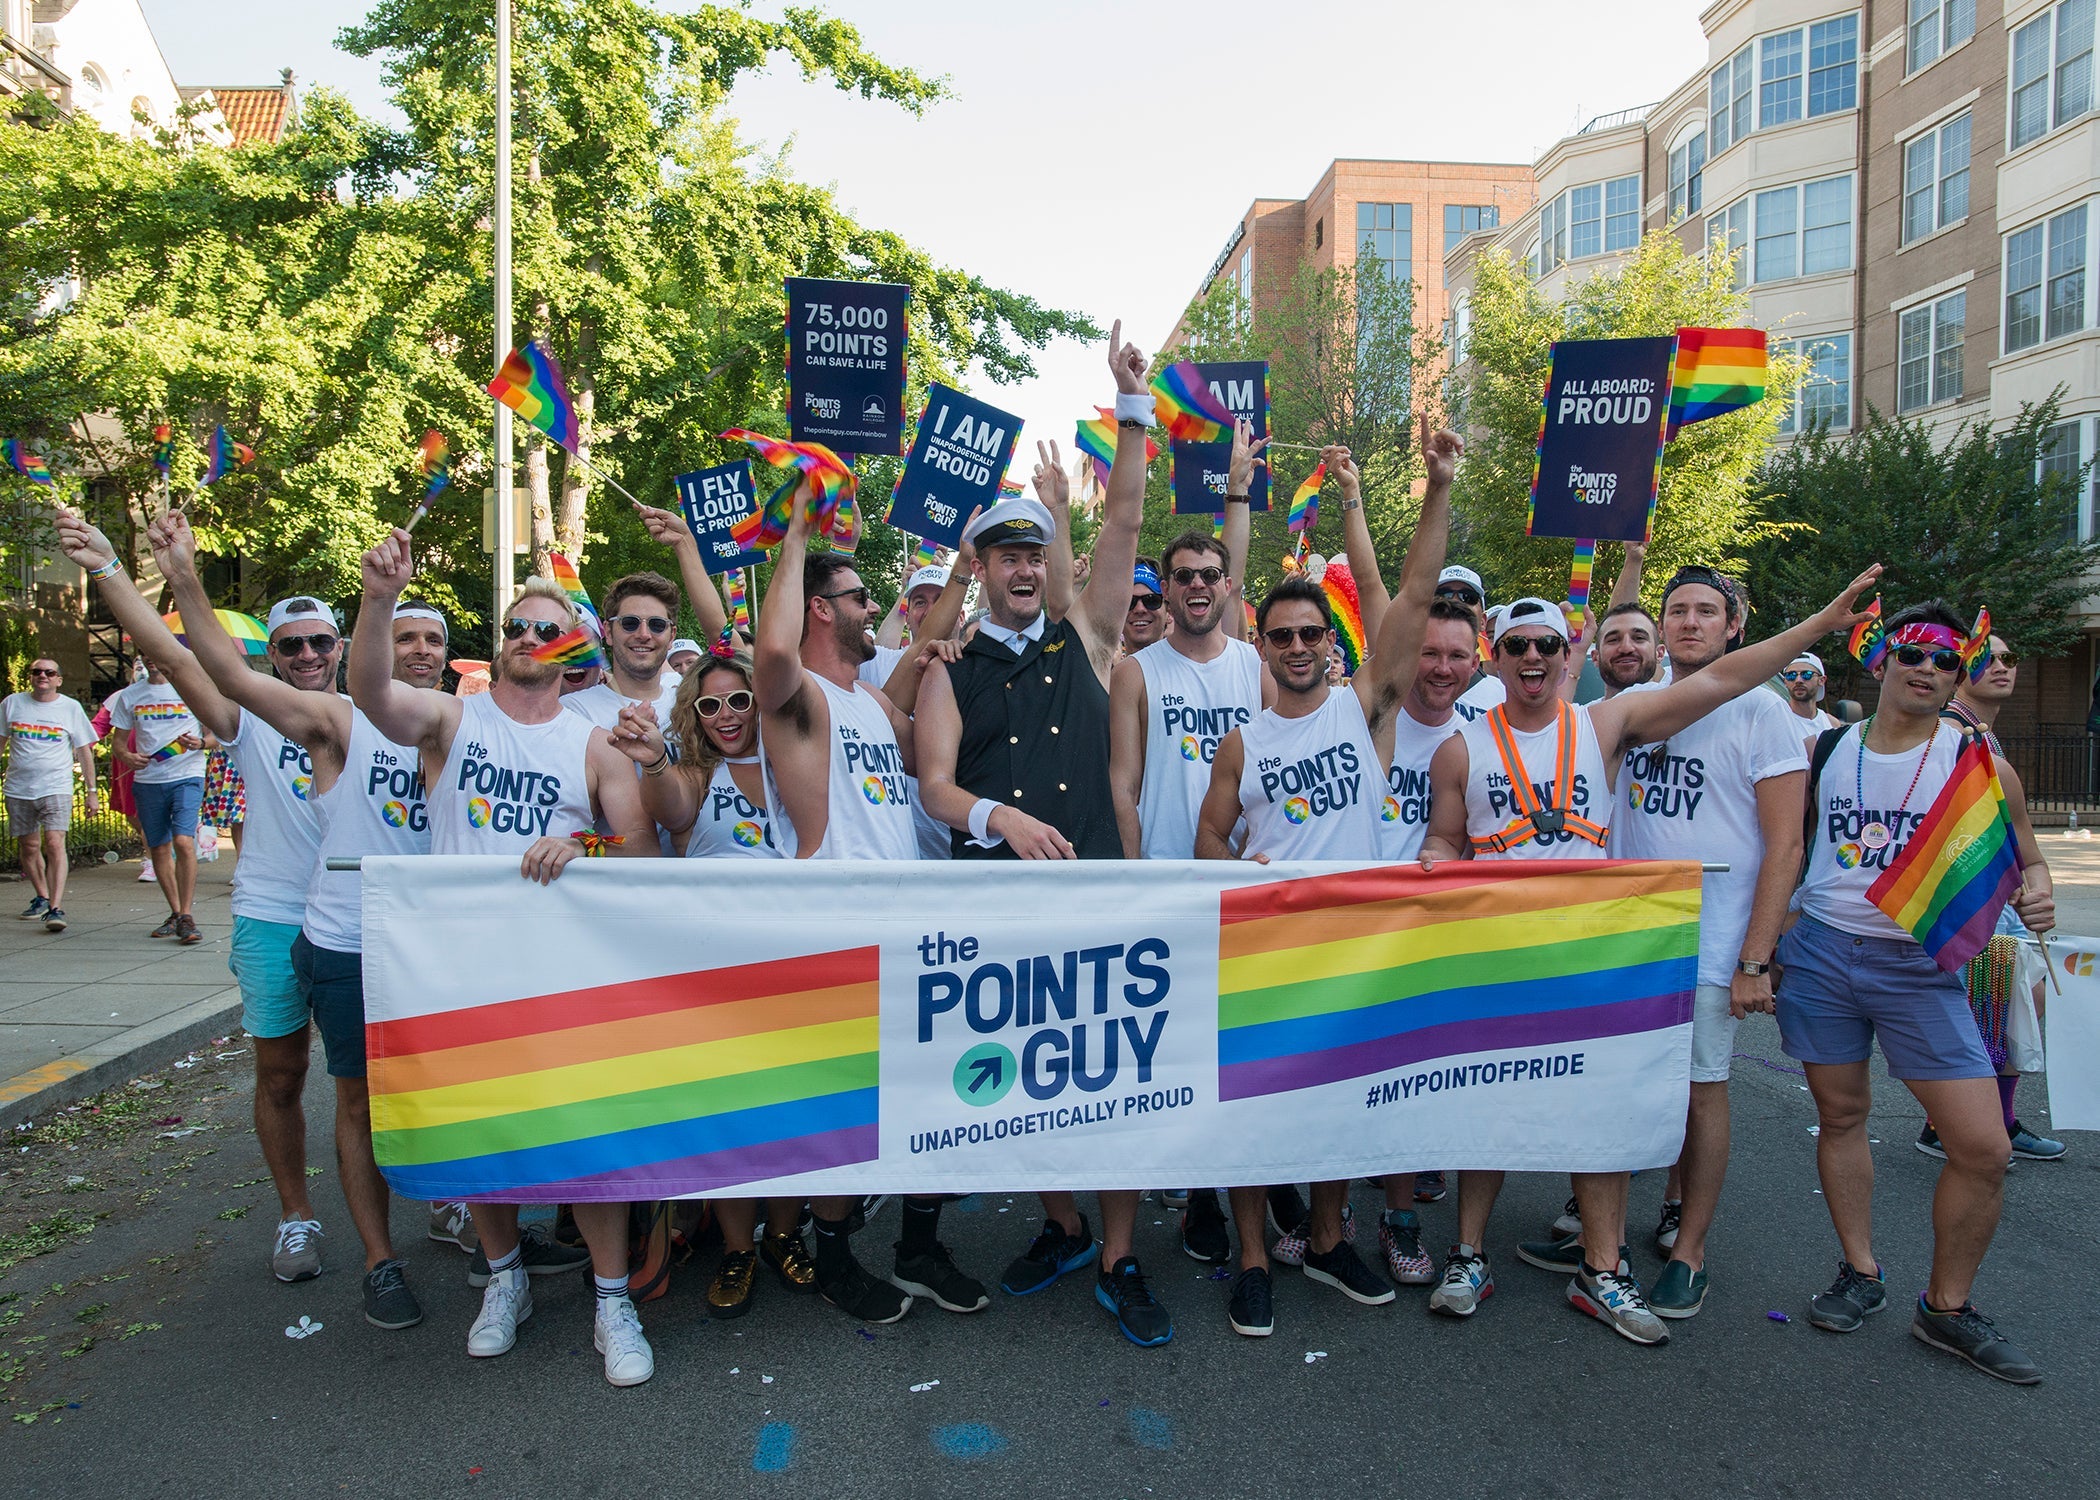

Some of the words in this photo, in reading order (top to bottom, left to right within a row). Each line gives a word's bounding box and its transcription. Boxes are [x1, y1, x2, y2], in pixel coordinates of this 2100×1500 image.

[804, 303, 888, 330] 75,000
[806, 330, 888, 356] POINTS
[806, 355, 826, 366] CAN
[829, 358, 854, 368] SAVE
[856, 359, 864, 368] A
[866, 360, 886, 370] LIFE
[1562, 380, 1587, 395] ALL
[1590, 378, 1655, 395] ABOARD:
[805, 397, 841, 409] POINTS
[819, 408, 841, 419] GUY
[1558, 396, 1651, 425] PROUD
[803, 426, 888, 439] thepointsguy.com/rainbow
[933, 404, 950, 435] I
[950, 414, 1005, 458] AM
[930, 435, 995, 467] UNAPOLOGETICALLY
[923, 445, 991, 487] PROUD
[1570, 464, 1583, 473] the
[687, 482, 697, 503] I
[702, 470, 741, 499] FLY
[1202, 474, 1229, 485] POINT
[1568, 473, 1617, 489] POINTS
[691, 492, 748, 521] LOUD
[923, 498, 958, 518] POINTS
[927, 492, 937, 500] the
[1585, 489, 1616, 505] GUY
[696, 523, 706, 534] &
[933, 512, 956, 528] GUY
[134, 703, 188, 721] PRIDE
[1161, 694, 1184, 707] the
[11, 721, 63, 743] PRIDE
[839, 725, 860, 740] the
[1163, 706, 1250, 736] POINTS
[373, 750, 397, 766] the
[467, 741, 488, 759] the
[1258, 756, 1282, 772] the
[1260, 742, 1359, 804] POINTS
[368, 766, 425, 801] POI
[458, 758, 561, 806] POINTS
[1389, 765, 1430, 797] OIN
[1486, 772, 1511, 788] the
[1309, 773, 1361, 817] GUY
[1488, 774, 1590, 819] PONS
[1643, 784, 1703, 821] GUY
[1830, 796, 1853, 811] the
[491, 802, 553, 837] GUY
[1401, 797, 1431, 825] GU
[917, 931, 979, 967] the
[918, 937, 1171, 1043] POINTS
[1021, 1010, 1170, 1101] GUY
[1366, 1053, 1585, 1109] #MYPOINTOFPRIDE
[909, 1099, 1118, 1154] UNAPOLOGETICALLY
[1123, 1086, 1194, 1116] PROUD
